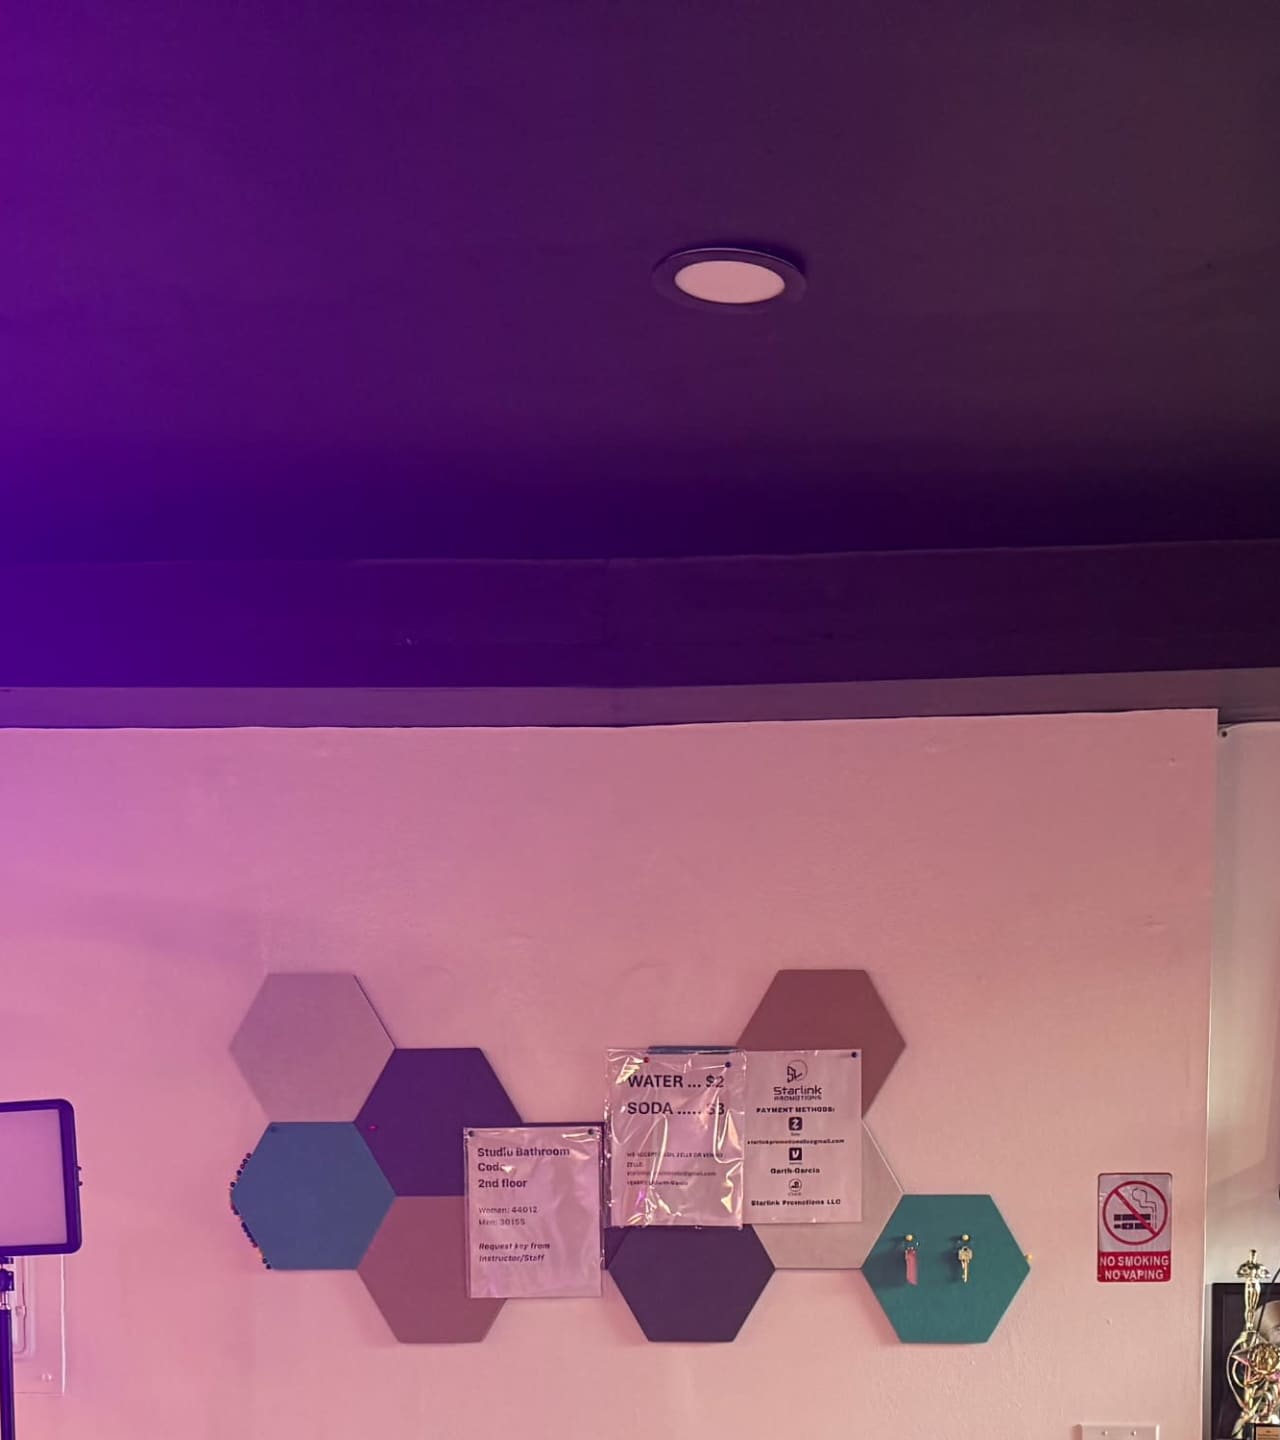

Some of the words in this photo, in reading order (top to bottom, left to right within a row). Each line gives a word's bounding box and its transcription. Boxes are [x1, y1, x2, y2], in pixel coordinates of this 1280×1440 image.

[628, 1075, 683, 1088] WATER
[705, 1074, 725, 1088] $2
[773, 1085, 822, 1096] Starlink
[627, 1102, 673, 1115] SODA
[516, 1147, 570, 1156] Bathroom
[478, 1179, 499, 1188] 2nd
[502, 1179, 528, 1188] floor
[479, 1243, 512, 1251] Request
[479, 1254, 545, 1262] Instructor/Staff
[1100, 1256, 1115, 1266] NO
[1118, 1256, 1169, 1266] SMOKING
[1105, 1270, 1120, 1280] NO
[1122, 1270, 1164, 1280] VAPING
